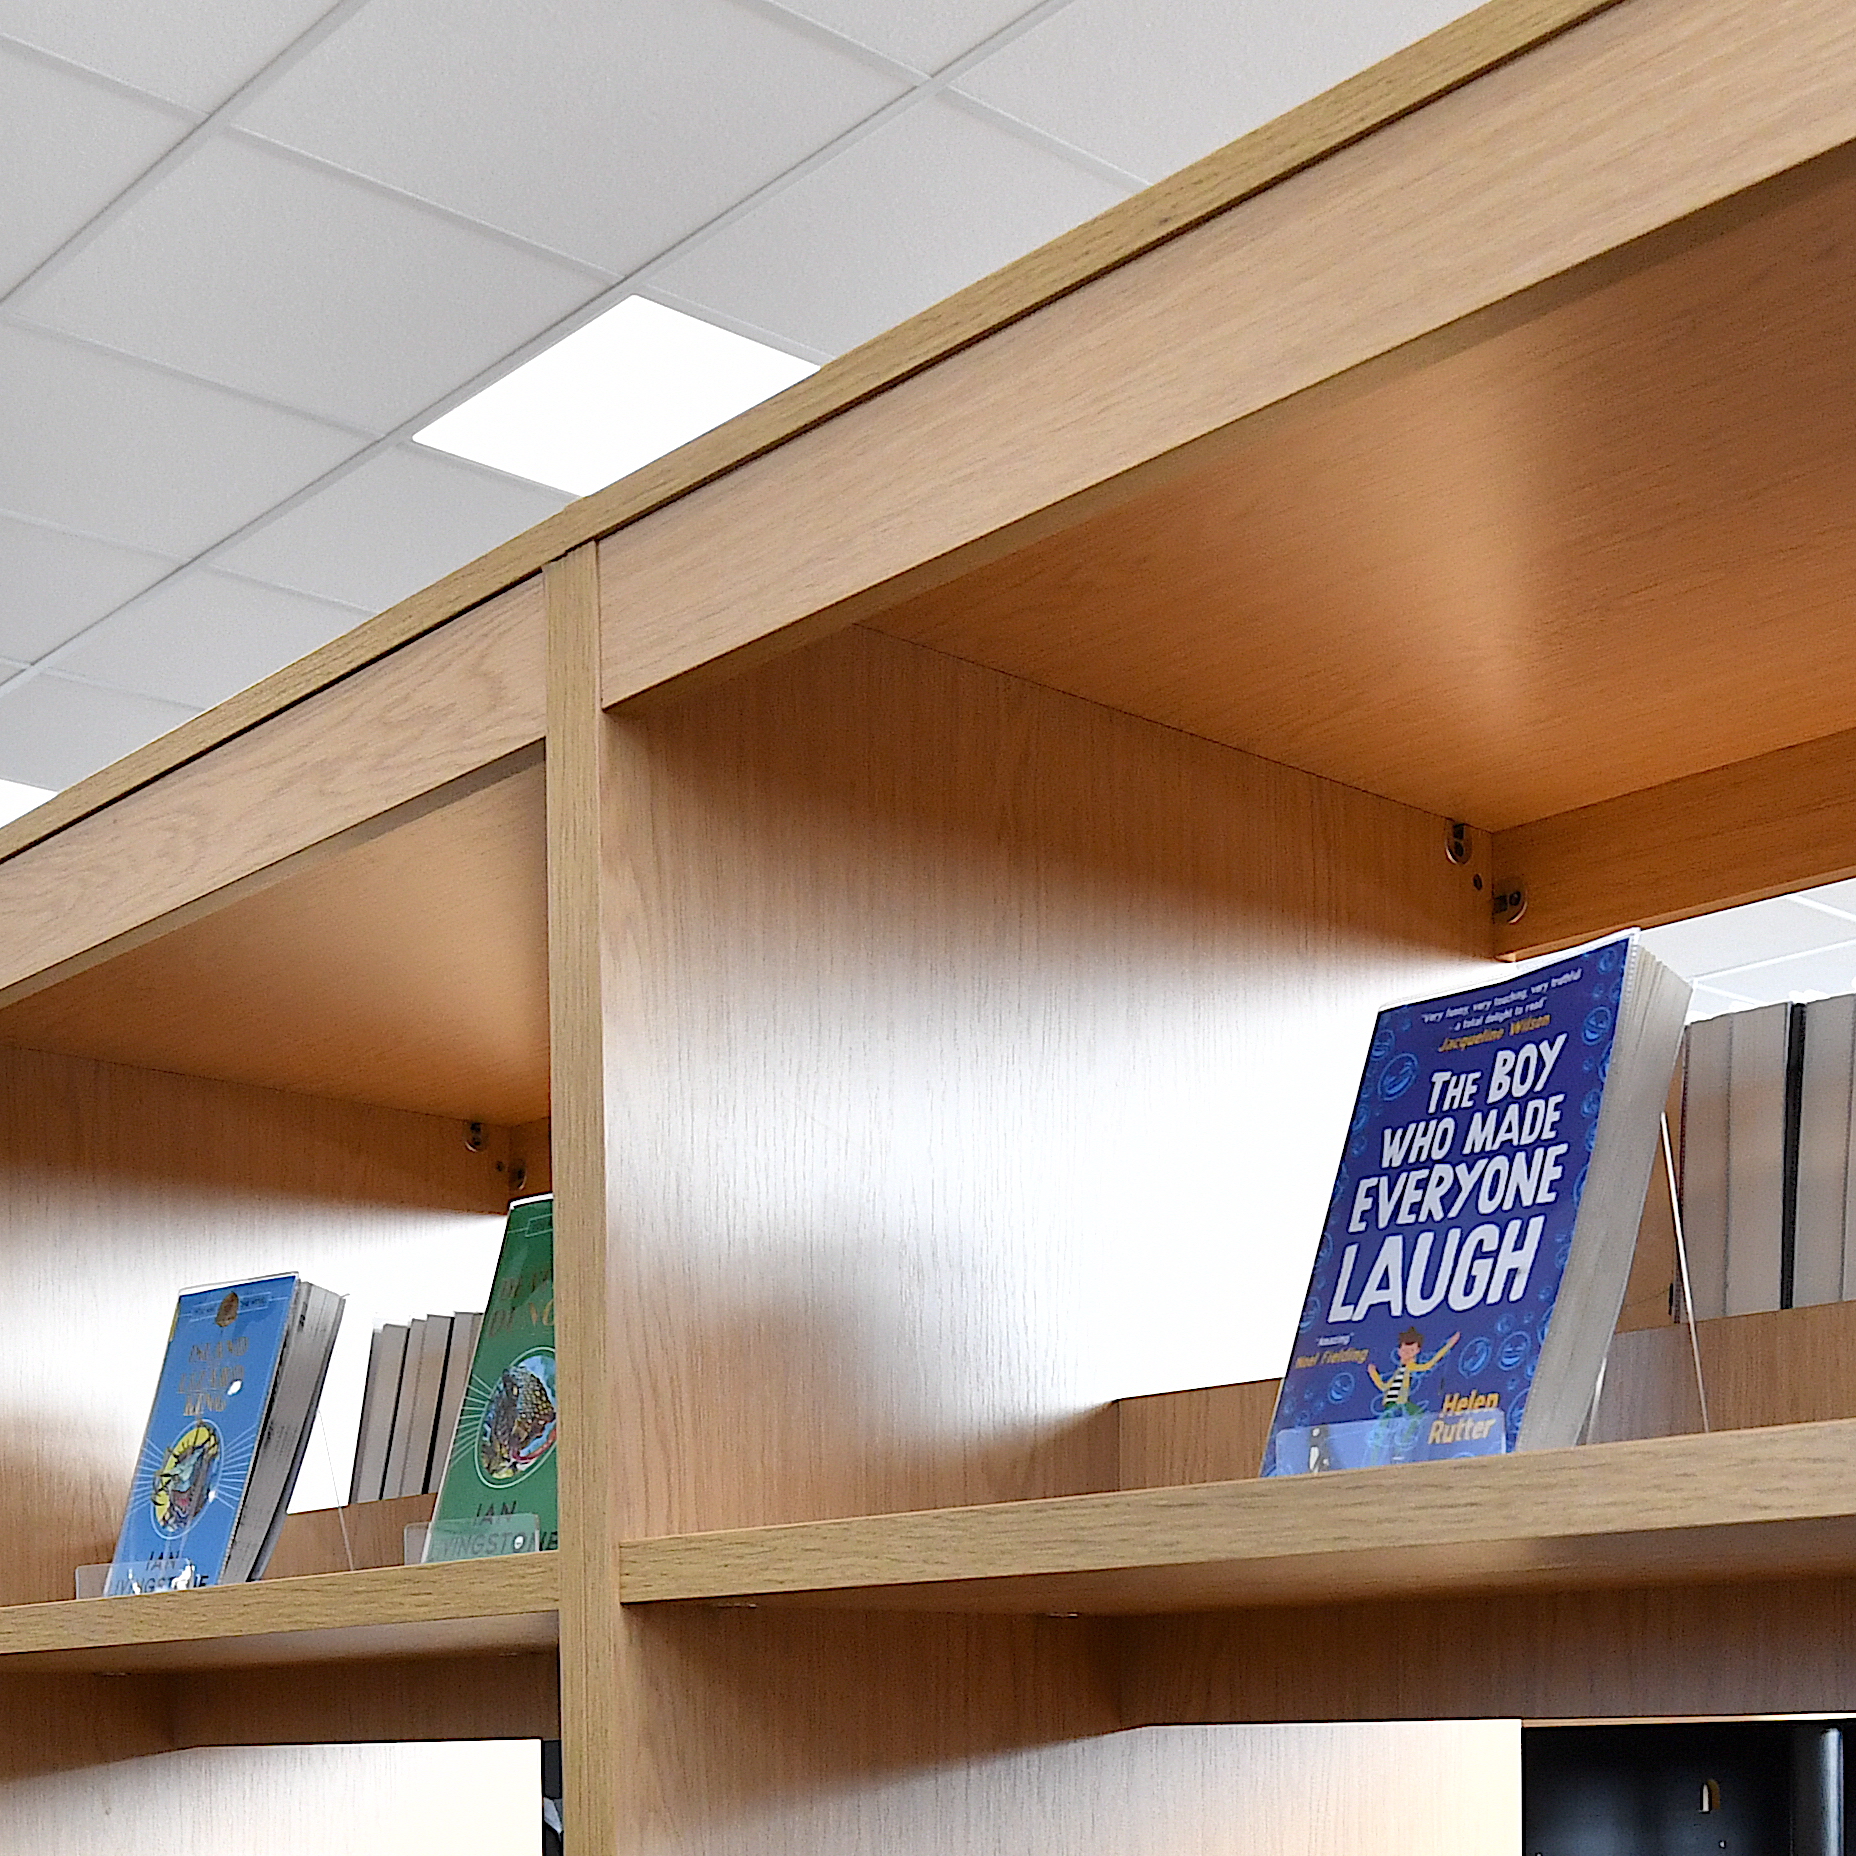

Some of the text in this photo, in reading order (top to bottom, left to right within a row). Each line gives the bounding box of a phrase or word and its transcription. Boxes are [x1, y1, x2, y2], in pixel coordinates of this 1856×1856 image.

[1427, 1033, 1569, 1114] THE BOY
[1381, 1094, 1566, 1169] WHO MADE
[1347, 1142, 1569, 1234] EVERYONE
[1326, 1213, 1547, 1324] LAUGH
[1440, 1388, 1500, 1418] Helen
[1427, 1417, 1497, 1445] Rutter
[473, 1500, 517, 1526] IAN
[145, 1549, 181, 1571] IAN
[428, 1530, 559, 1561] VINGSTONE
